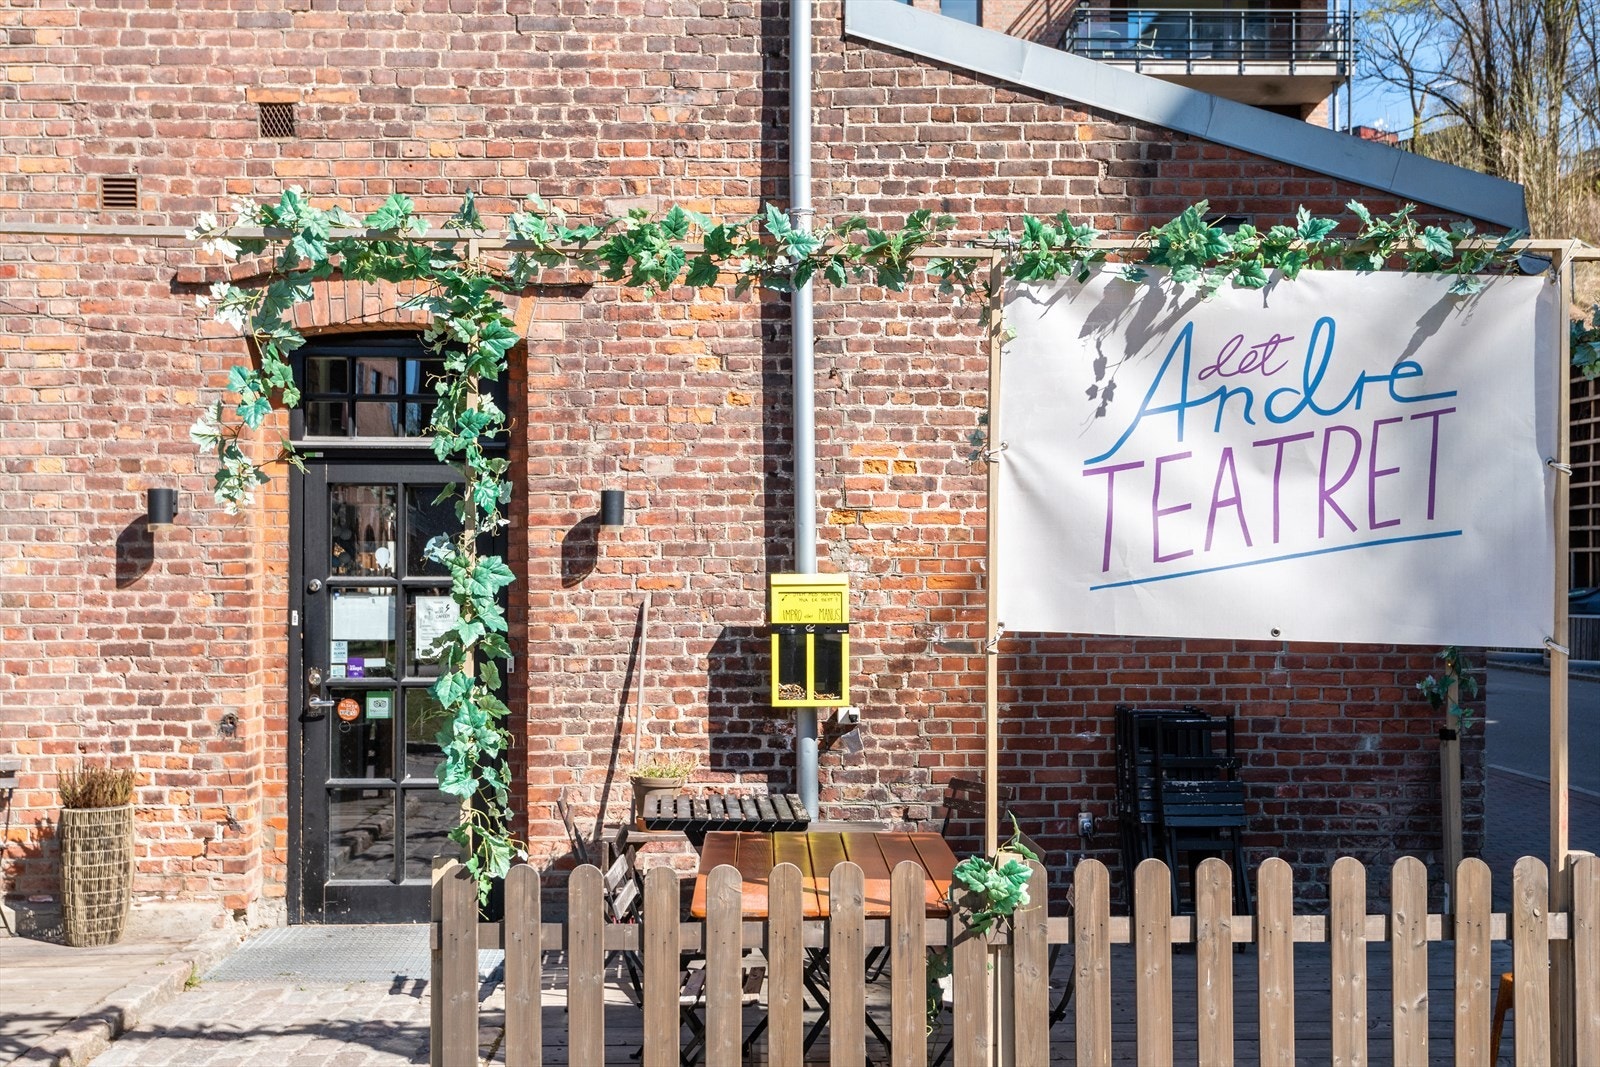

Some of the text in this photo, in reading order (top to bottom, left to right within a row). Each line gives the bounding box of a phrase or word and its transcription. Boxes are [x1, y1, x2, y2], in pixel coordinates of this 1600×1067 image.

[1084, 315, 1457, 465] Andre
[1198, 333, 1295, 380] det
[1082, 406, 1456, 573] TEATRET
[782, 608, 802, 621] IMPRO
[819, 608, 840, 621] MANUS
